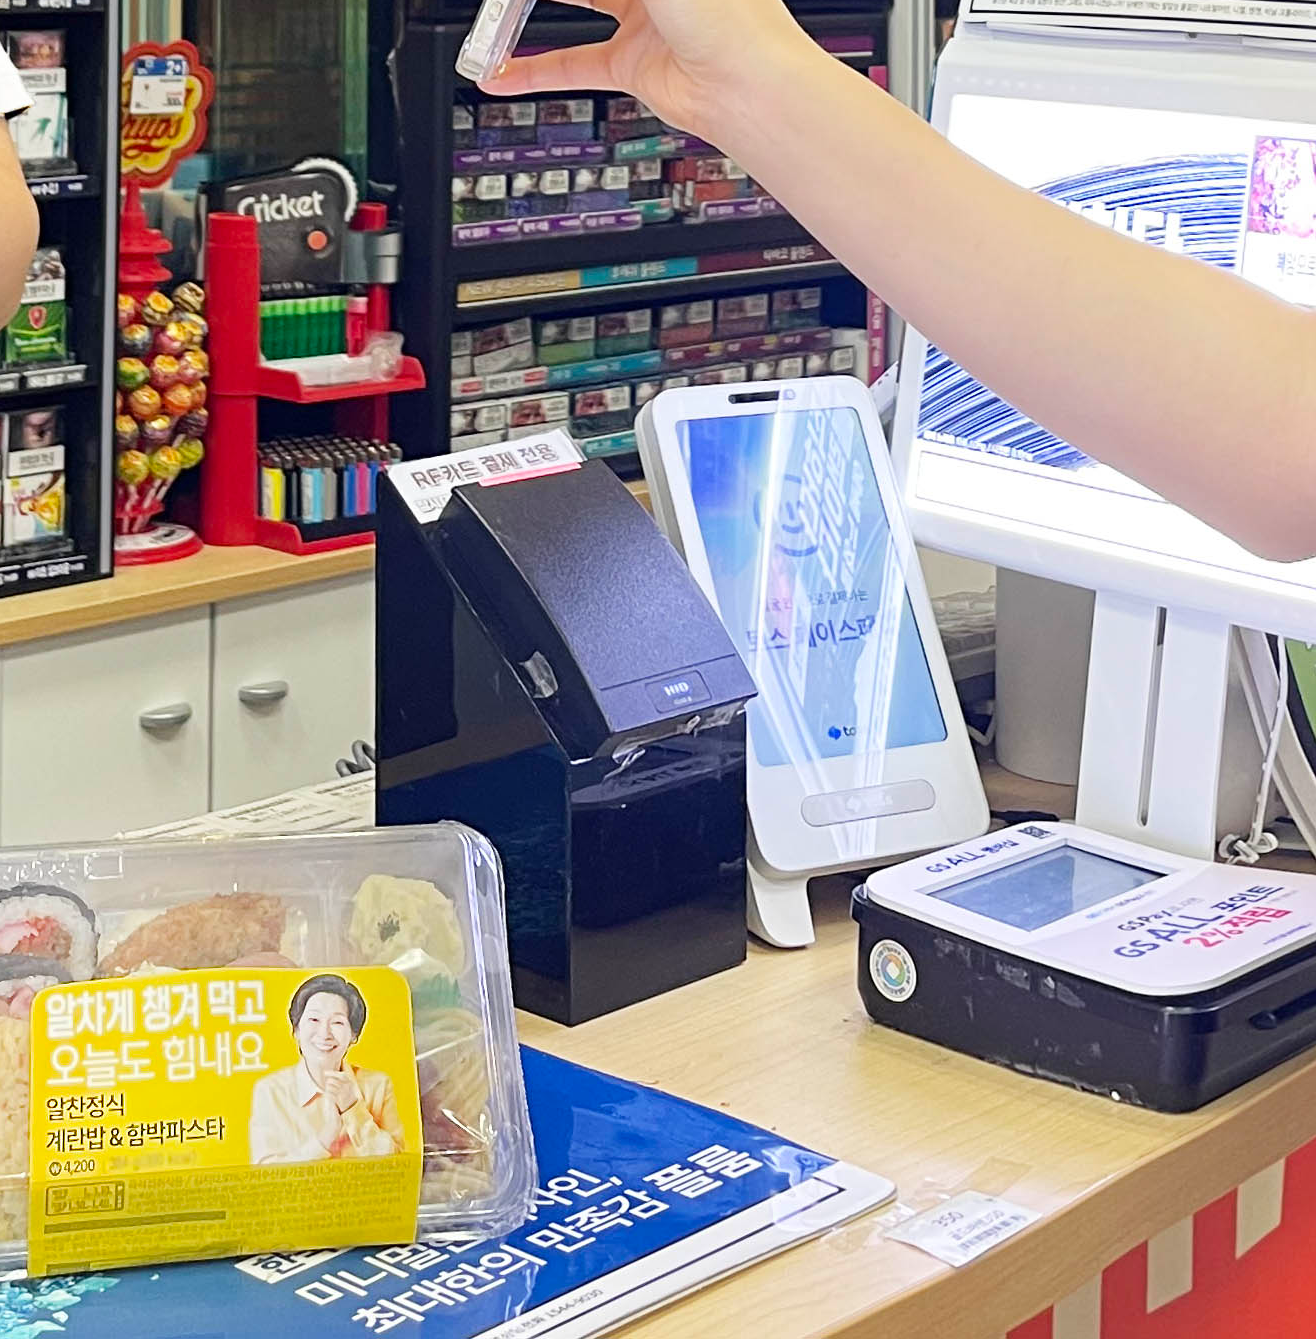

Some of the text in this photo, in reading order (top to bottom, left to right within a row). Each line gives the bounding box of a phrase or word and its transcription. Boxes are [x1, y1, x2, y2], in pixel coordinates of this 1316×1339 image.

[238, 191, 324, 223] Cricket
[411, 443, 558, 490] RF카드 결제 전용
[664, 682, 689, 696] HID
[925, 860, 950, 874] GS
[947, 849, 987, 868] ALL
[1113, 885, 1284, 959] GS ALL 포인트
[46, 980, 267, 1039] 알차게 챙겨 먹고
[46, 1031, 269, 1088] 오늘도 힘내요
[46, 1093, 125, 1121] 알찬정식
[46, 1116, 225, 1153] 계란밥 & 함박파스타
[64, 1159, 96, 1176] 4,200
[351, 1144, 764, 1334] 최대한의 만족감 플룸
